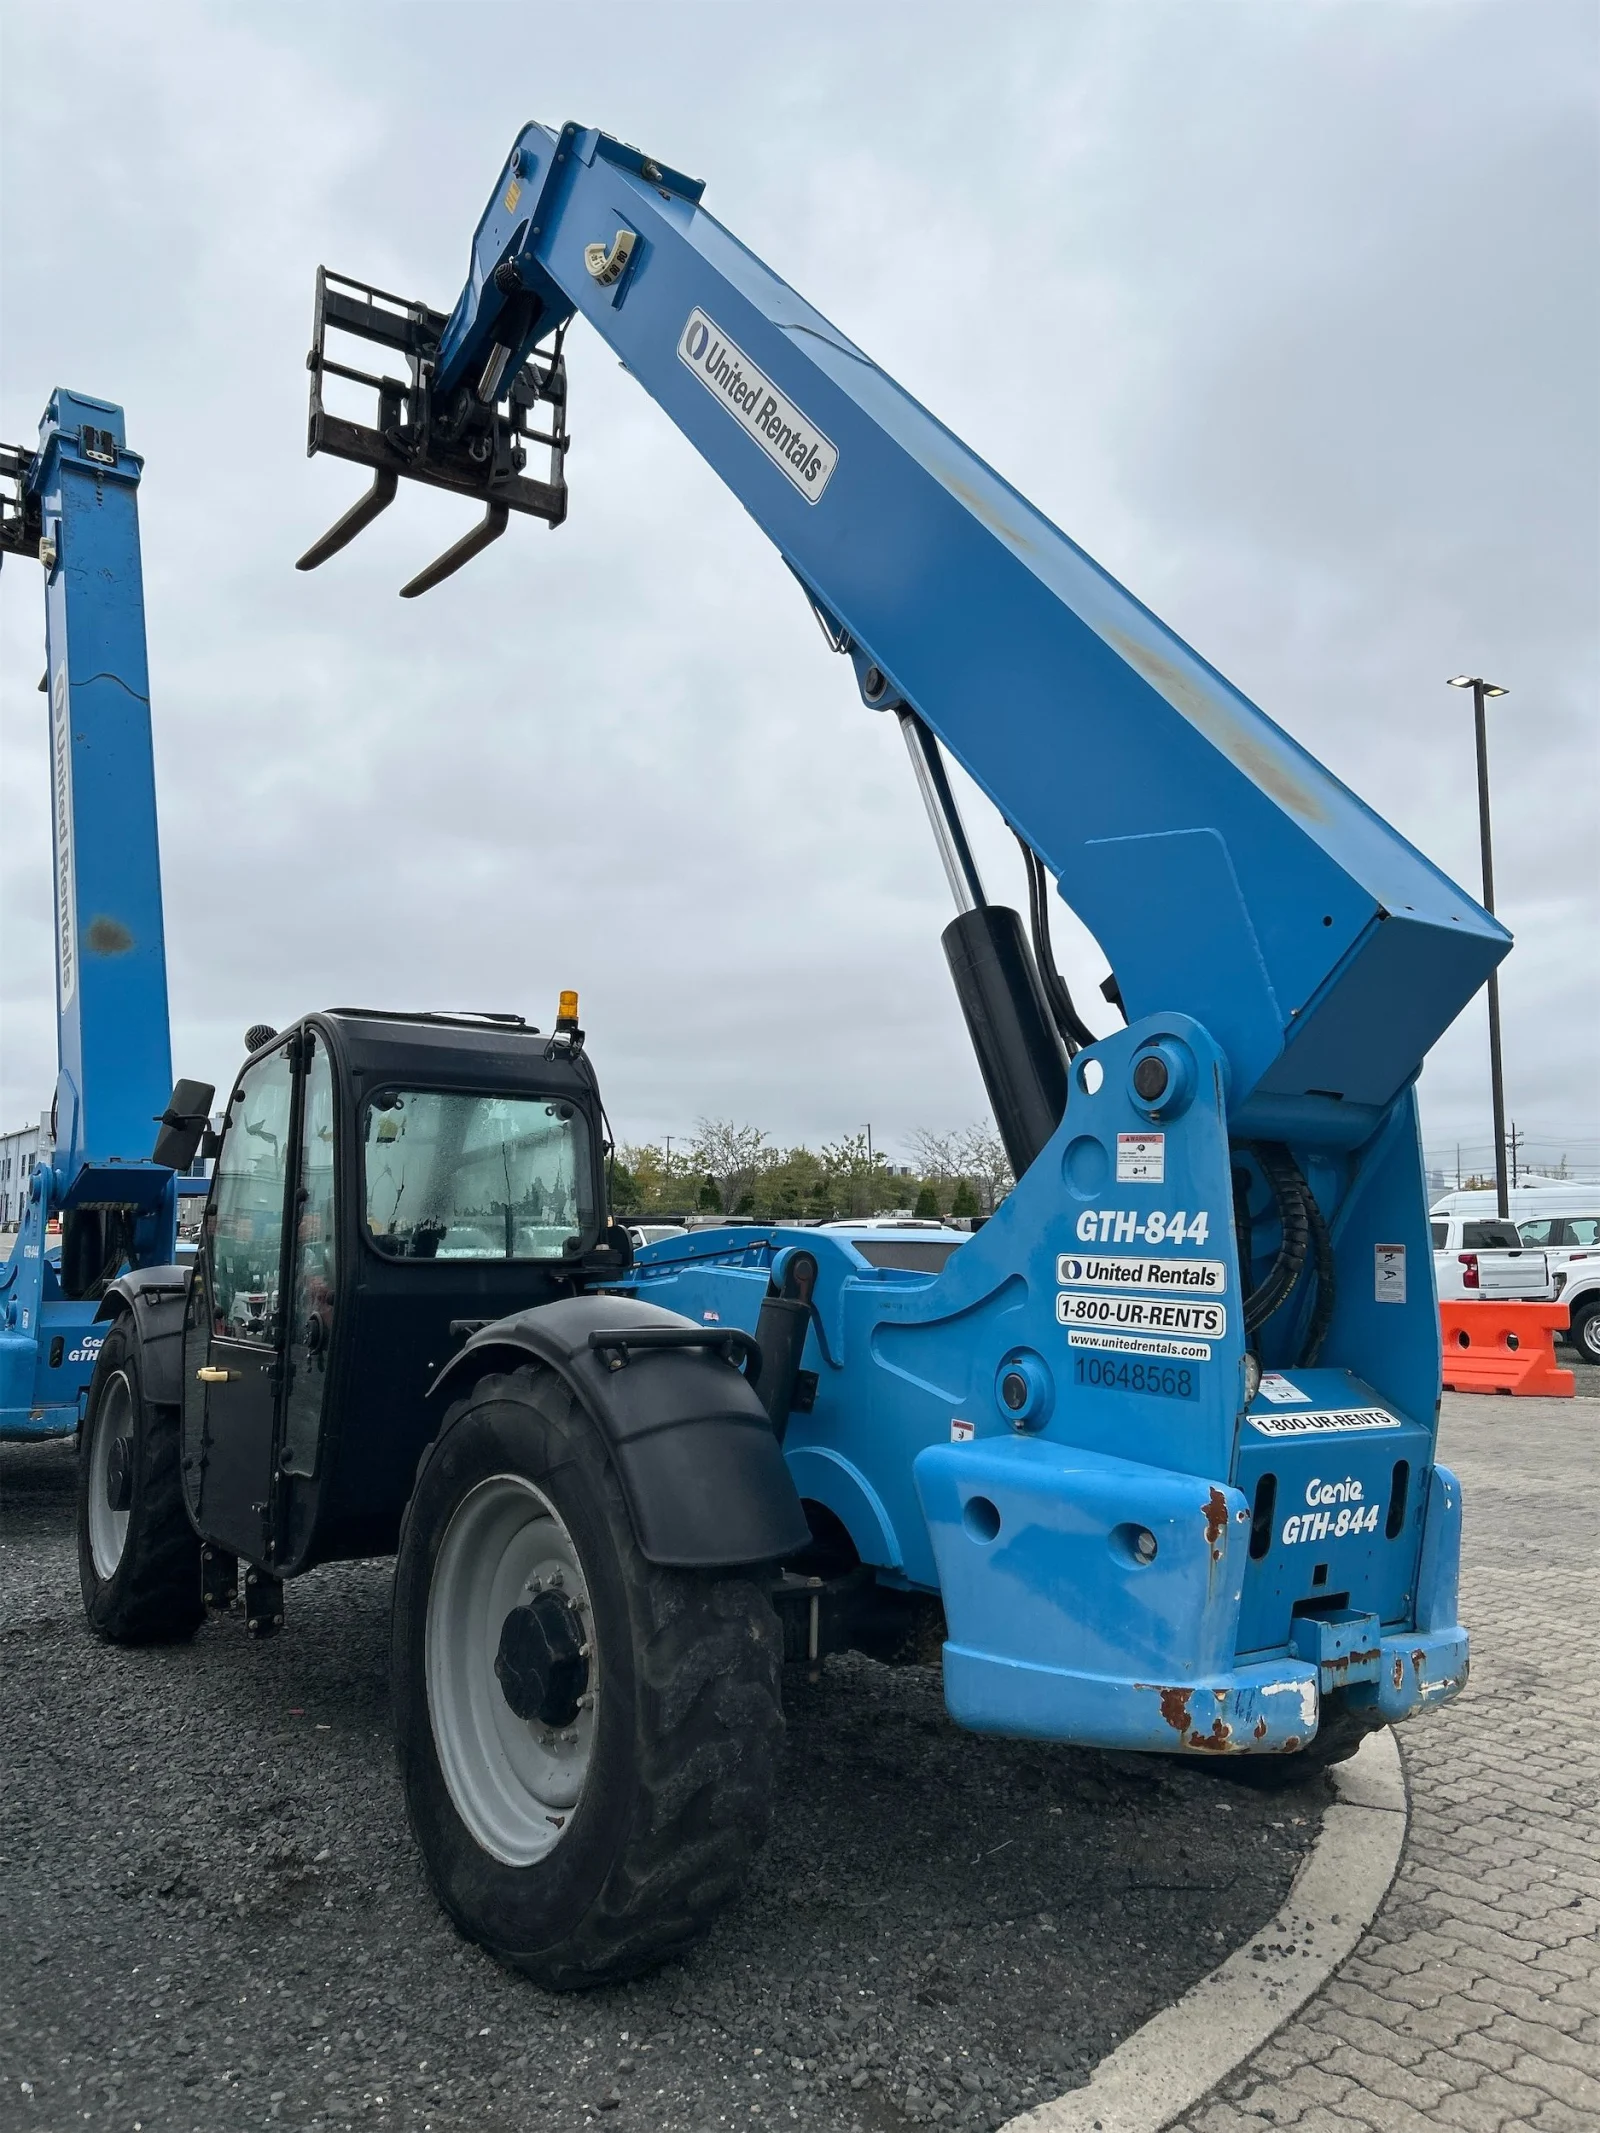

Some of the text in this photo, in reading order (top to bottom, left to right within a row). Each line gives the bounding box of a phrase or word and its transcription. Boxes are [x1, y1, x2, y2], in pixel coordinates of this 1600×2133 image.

[616, 250, 628, 264] 80
[705, 341, 821, 482] United Rentals
[57, 726, 72, 989] United Rentals
[1076, 1210, 1209, 1246] GTH-844
[1086, 1261, 1216, 1287] United Rentals
[1062, 1299, 1218, 1330] 1-800-UR-RENTS
[1070, 1334, 1207, 1358] www.unitedrentals.com
[1076, 1357, 1192, 1398] 10648568
[1257, 1411, 1391, 1432] 1-800-UR-RENTS
[1305, 1475, 1363, 1507] Genie
[1282, 1504, 1379, 1545] GTH-844
